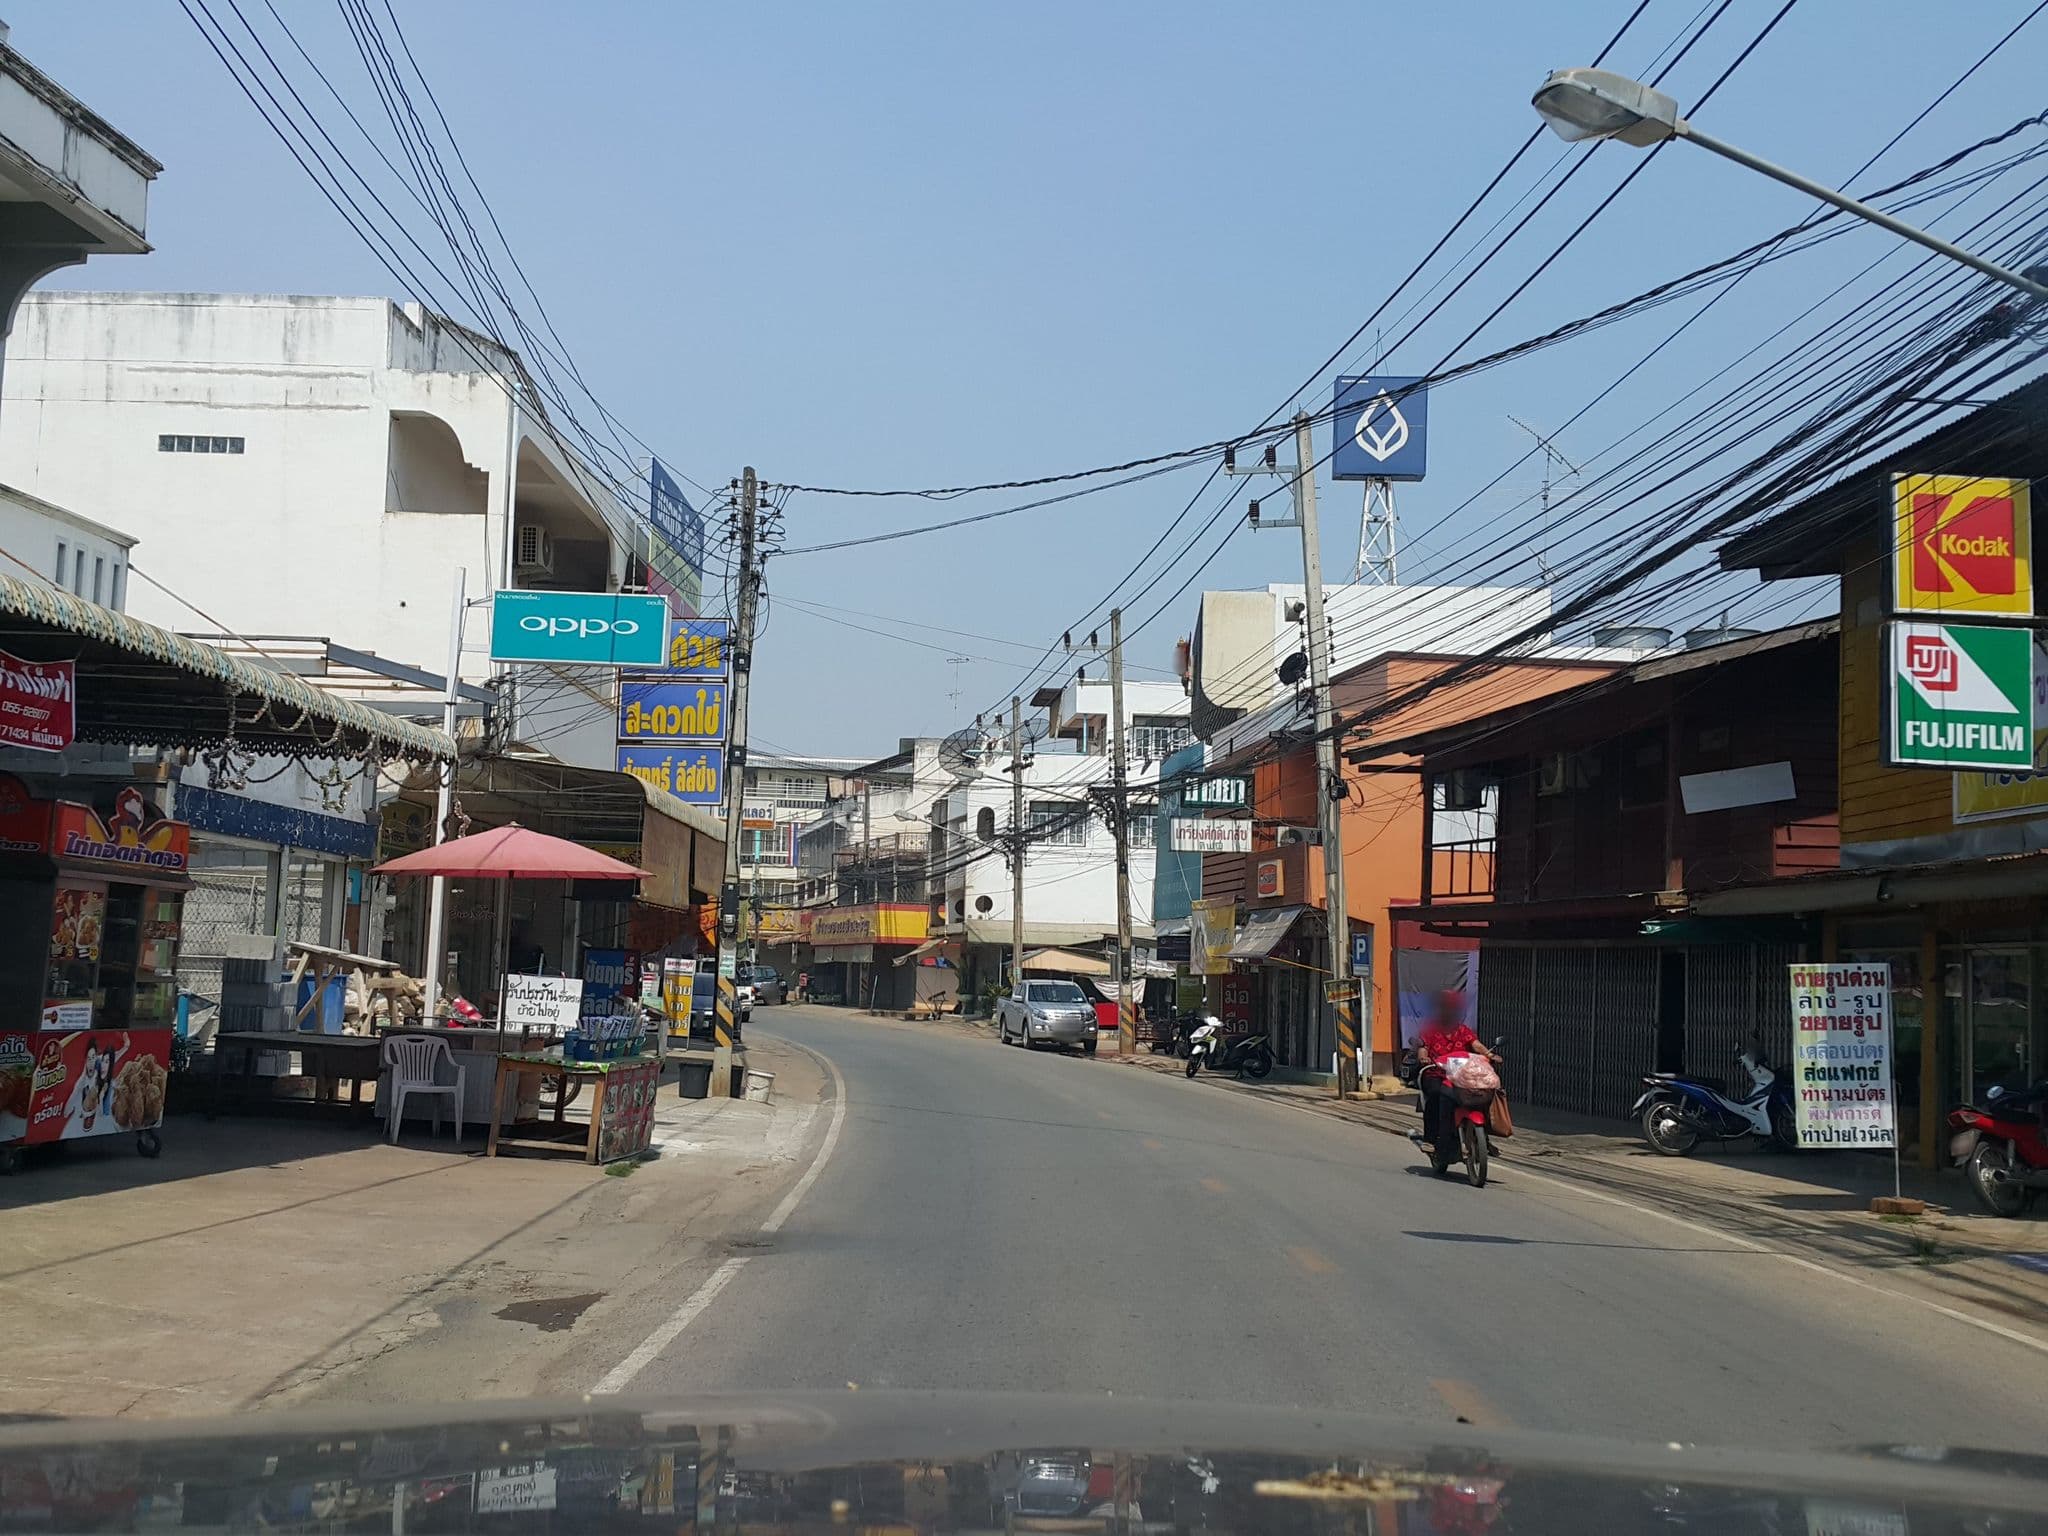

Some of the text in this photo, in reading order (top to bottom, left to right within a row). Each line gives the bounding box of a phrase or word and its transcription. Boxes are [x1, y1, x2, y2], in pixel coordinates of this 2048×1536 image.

[1941, 534, 2010, 557] Kodak
[519, 616, 640, 638] oppo
[1906, 720, 2023, 751] FUJIFILM
[1356, 939, 1366, 960] P
[1793, 966, 1885, 994] ถ่ายรูปด่วน
[1800, 1012, 1882, 1037] ขยายรูป
[1800, 1039, 1884, 1059] เคลือบบัตร
[1801, 1083, 1886, 1101] ทำนามบัตร
